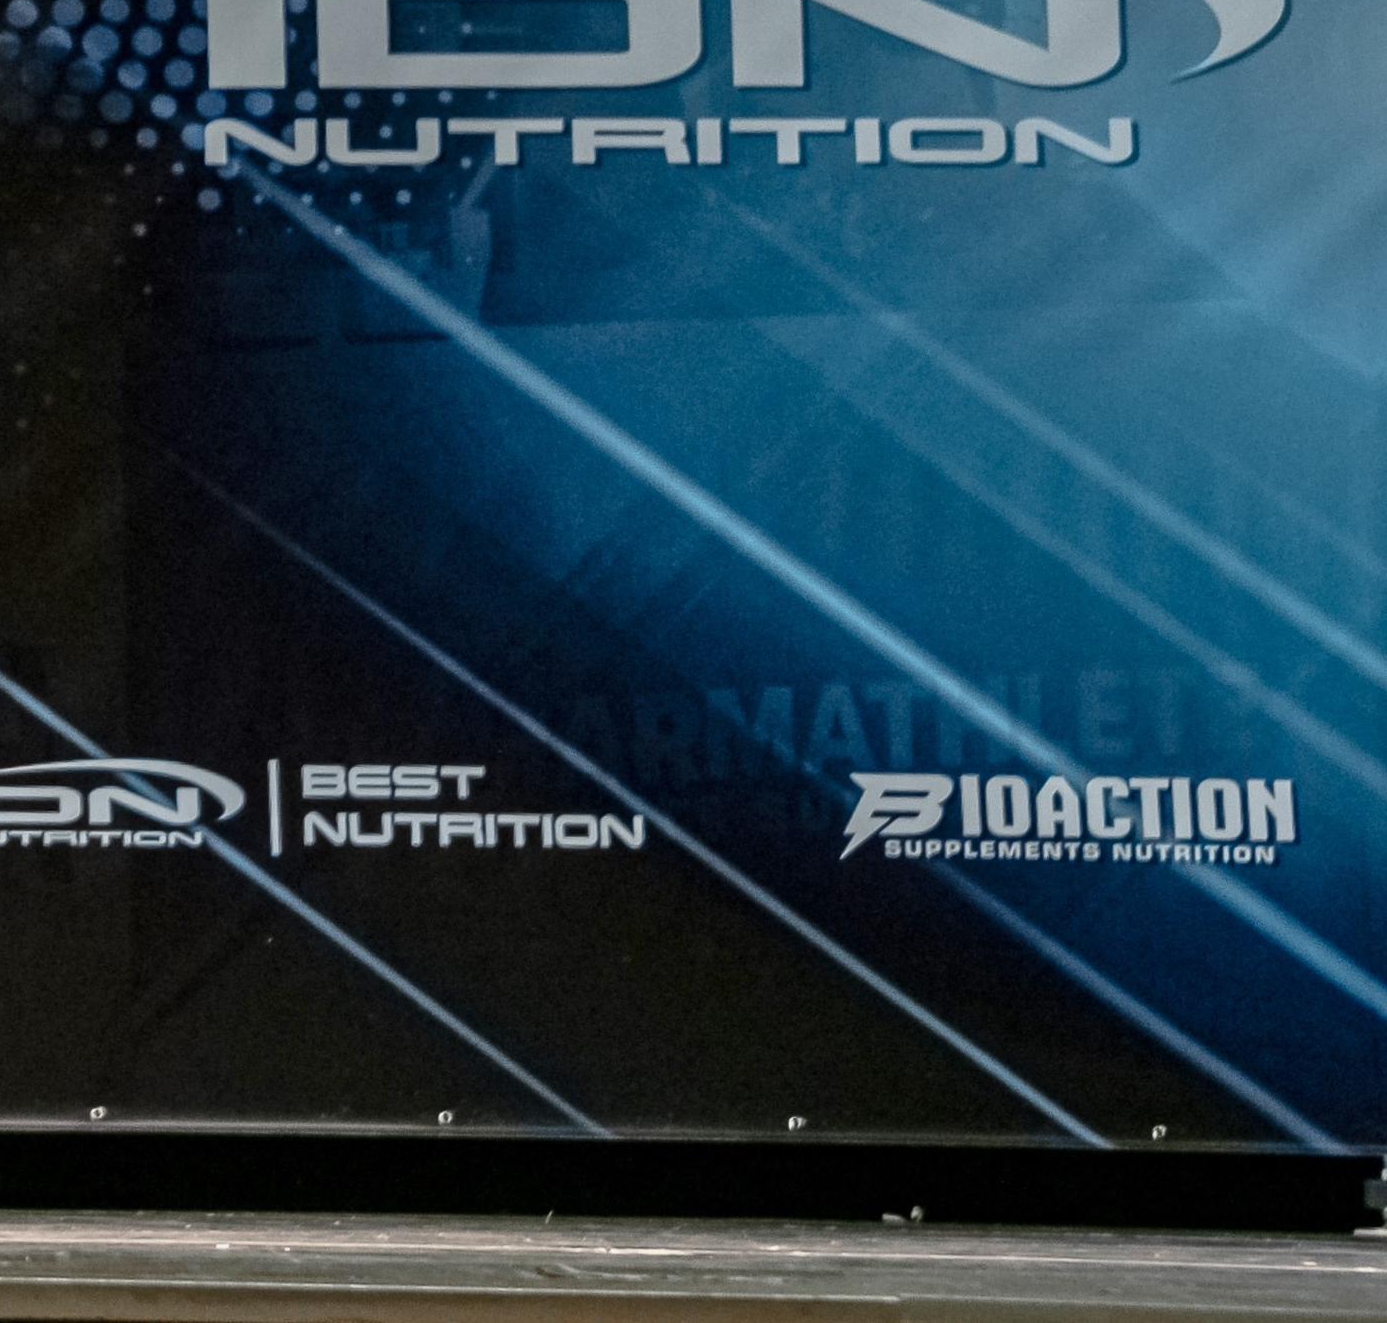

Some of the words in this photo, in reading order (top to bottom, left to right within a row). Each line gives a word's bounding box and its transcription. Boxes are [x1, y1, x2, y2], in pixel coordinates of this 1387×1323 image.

[203, 116, 1133, 166] NUTRITION
[301, 764, 486, 800] BEST
[302, 811, 645, 850] NUTRITION
[839, 772, 1296, 862] BIOACTION
[884, 839, 1100, 861] SUPPLEMENTS
[1112, 842, 1276, 865] NUTRITION
